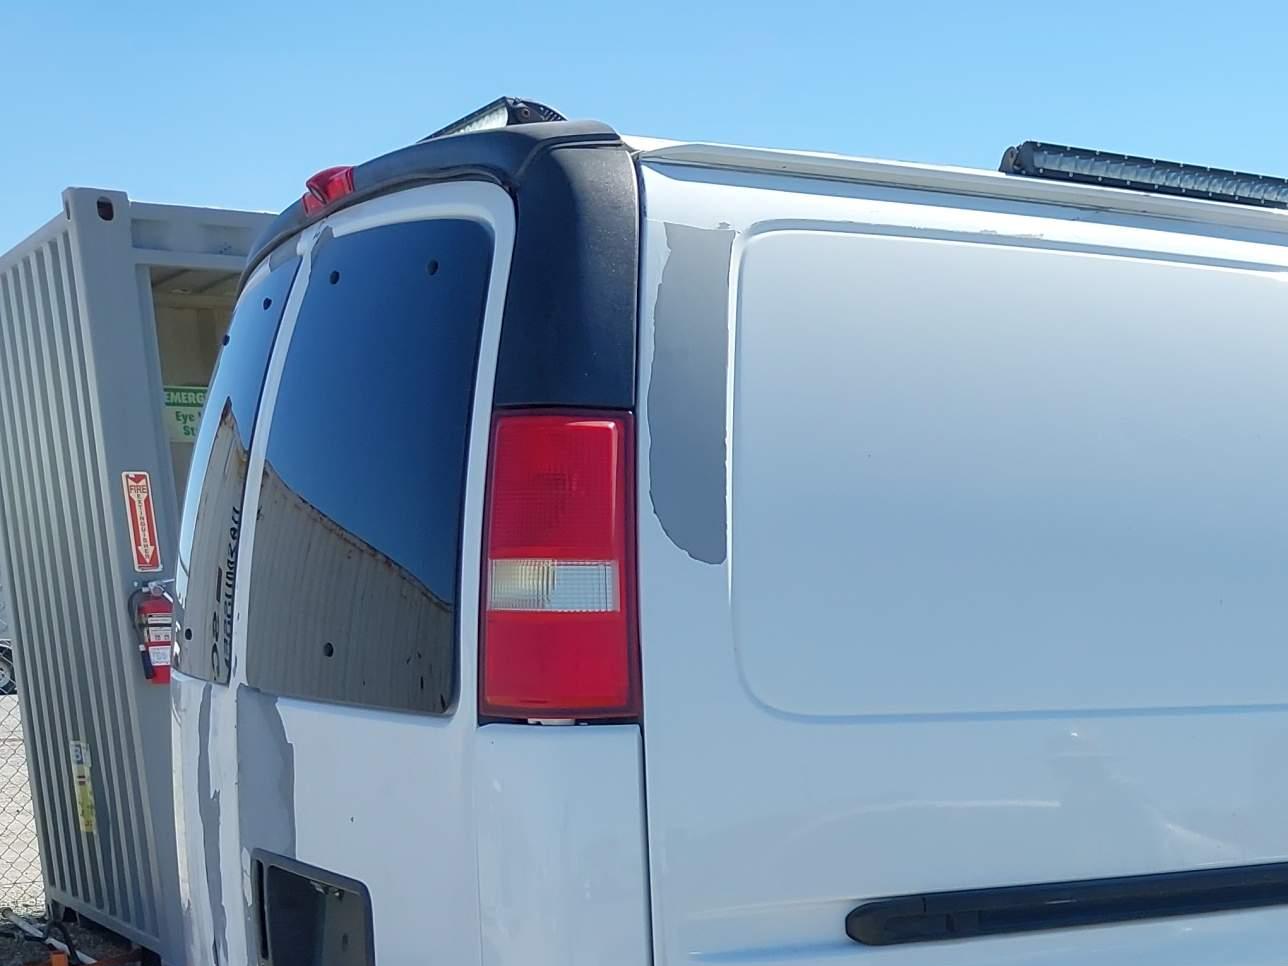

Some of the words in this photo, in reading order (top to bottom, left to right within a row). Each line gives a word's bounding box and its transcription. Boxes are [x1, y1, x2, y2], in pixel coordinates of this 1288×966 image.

[175, 411, 195, 424] Eye
[129, 484, 147, 493] FIRE
[136, 493, 150, 558] EXTINGUISHER
